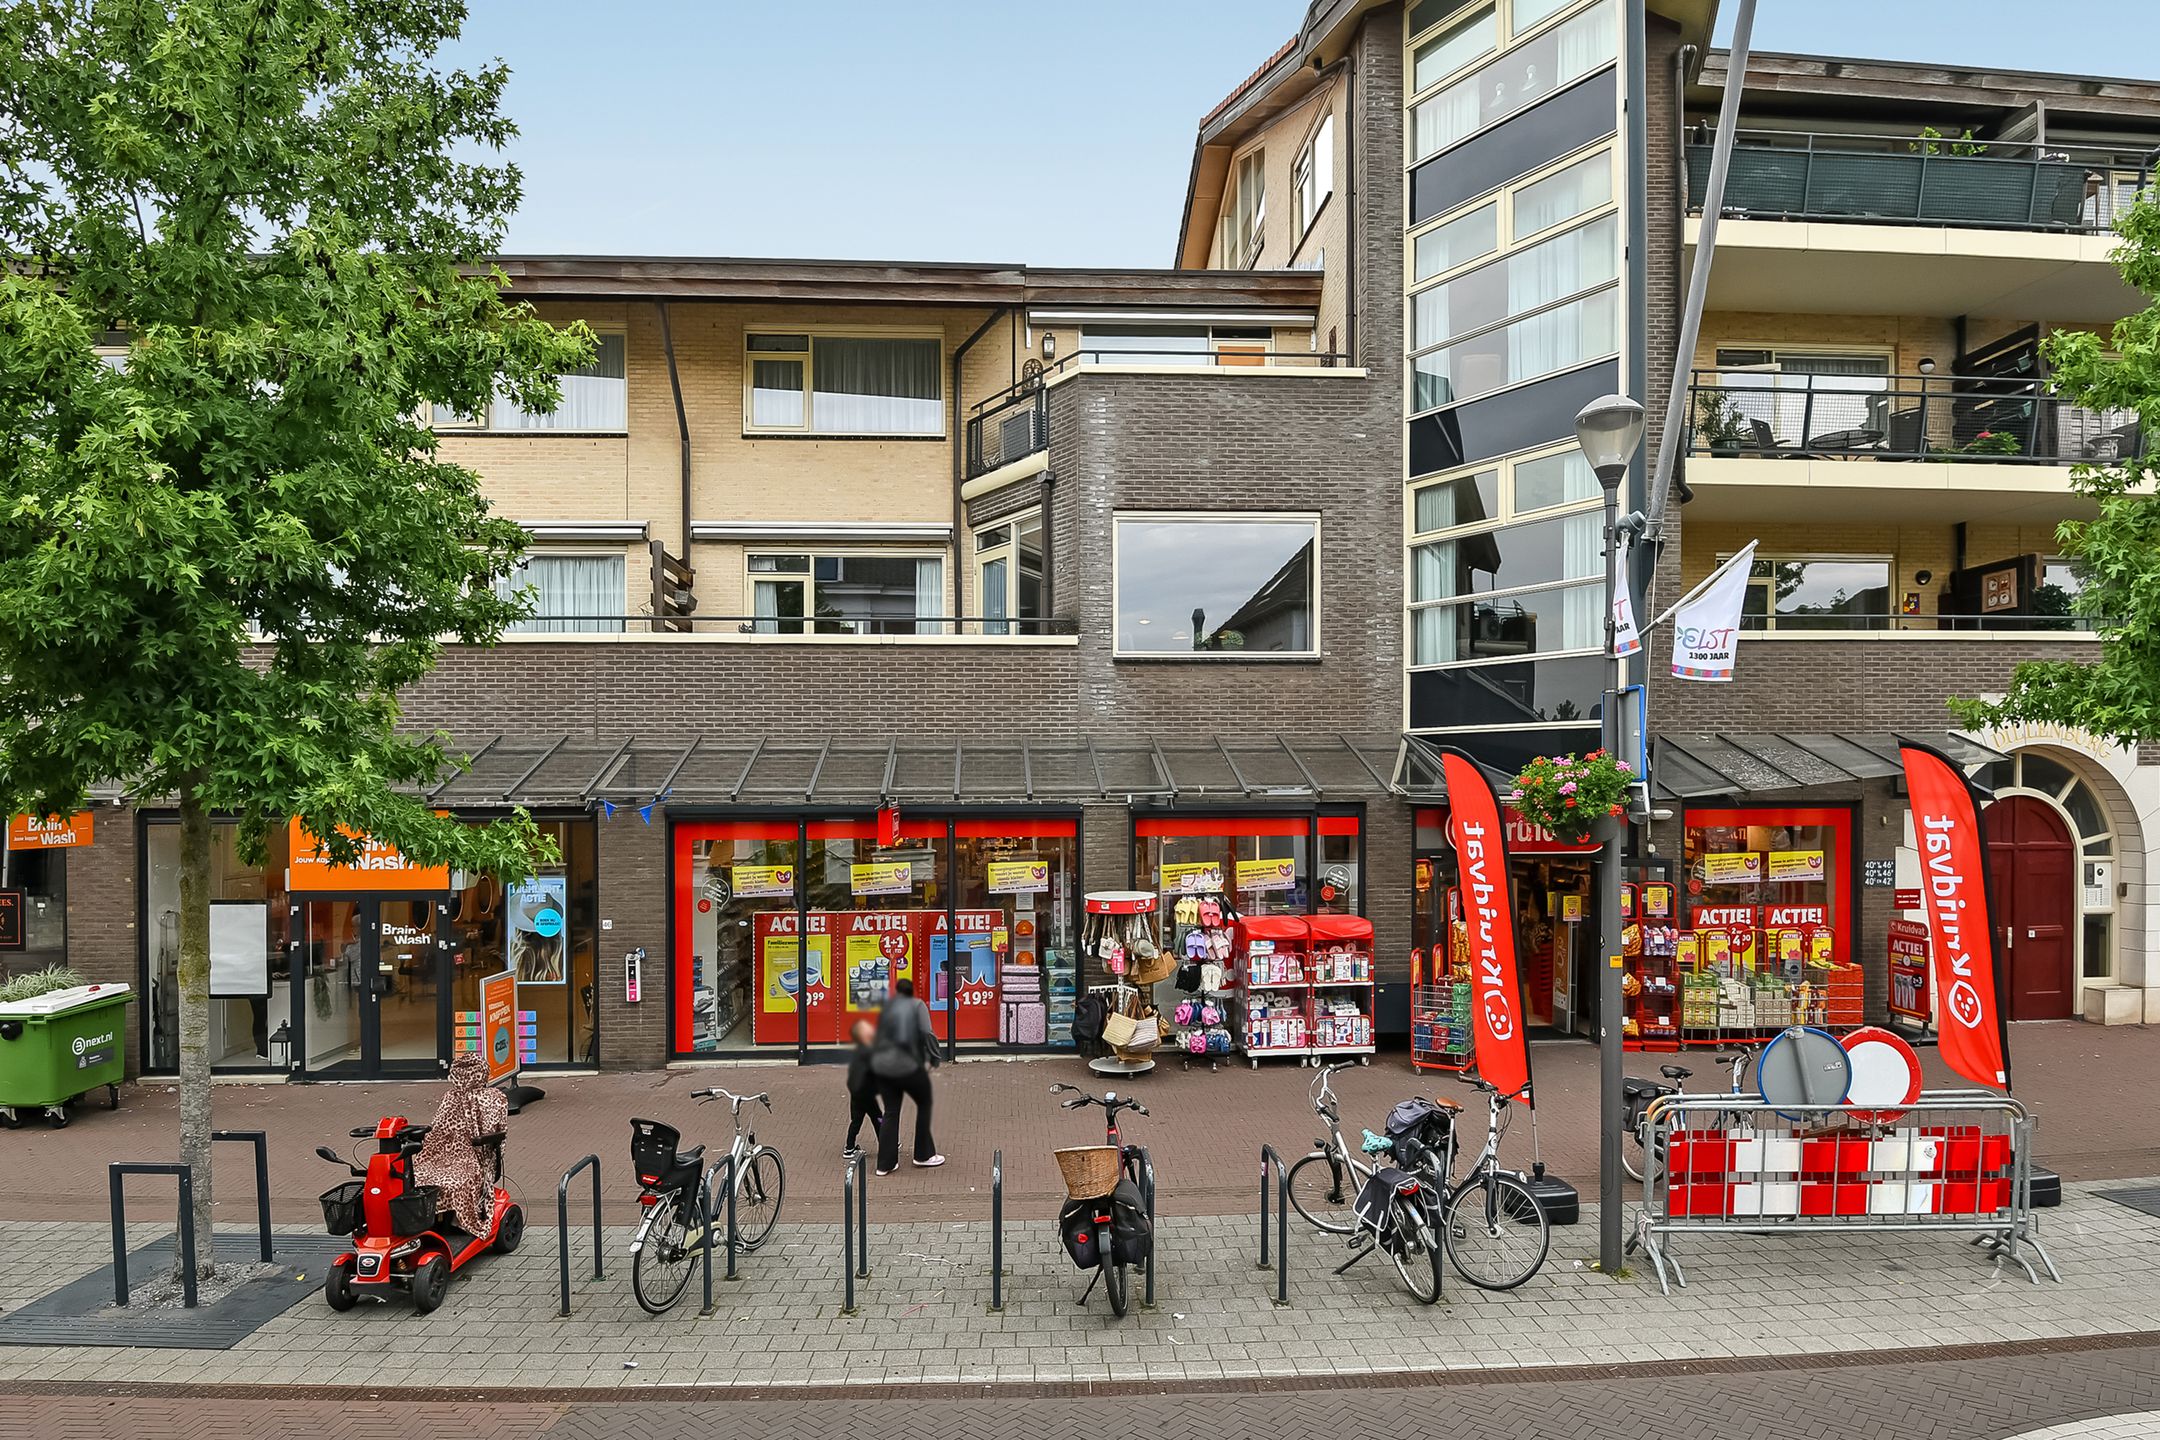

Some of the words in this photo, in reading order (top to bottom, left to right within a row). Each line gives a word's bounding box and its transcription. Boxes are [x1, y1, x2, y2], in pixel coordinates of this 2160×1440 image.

[1689, 652, 1708, 661] 1300
[1709, 652, 1729, 660] JAAR
[40, 829, 76, 845] Wash
[295, 856, 315, 864] Jouw
[520, 893, 547, 903] ACTIE
[852, 914, 907, 932] ACTIE!
[936, 914, 990, 930] ATIE!
[1699, 908, 1751, 925] ACTIE!
[1771, 908, 1822, 924] ACTIE!
[382, 923, 416, 935] Brain
[1897, 922, 1926, 936] Kruidvat
[394, 933, 431, 945] Wash
[884, 936, 904, 948] 1+1
[1892, 938, 1924, 956] ACTIE!
[86, 1031, 113, 1048] next.nl
